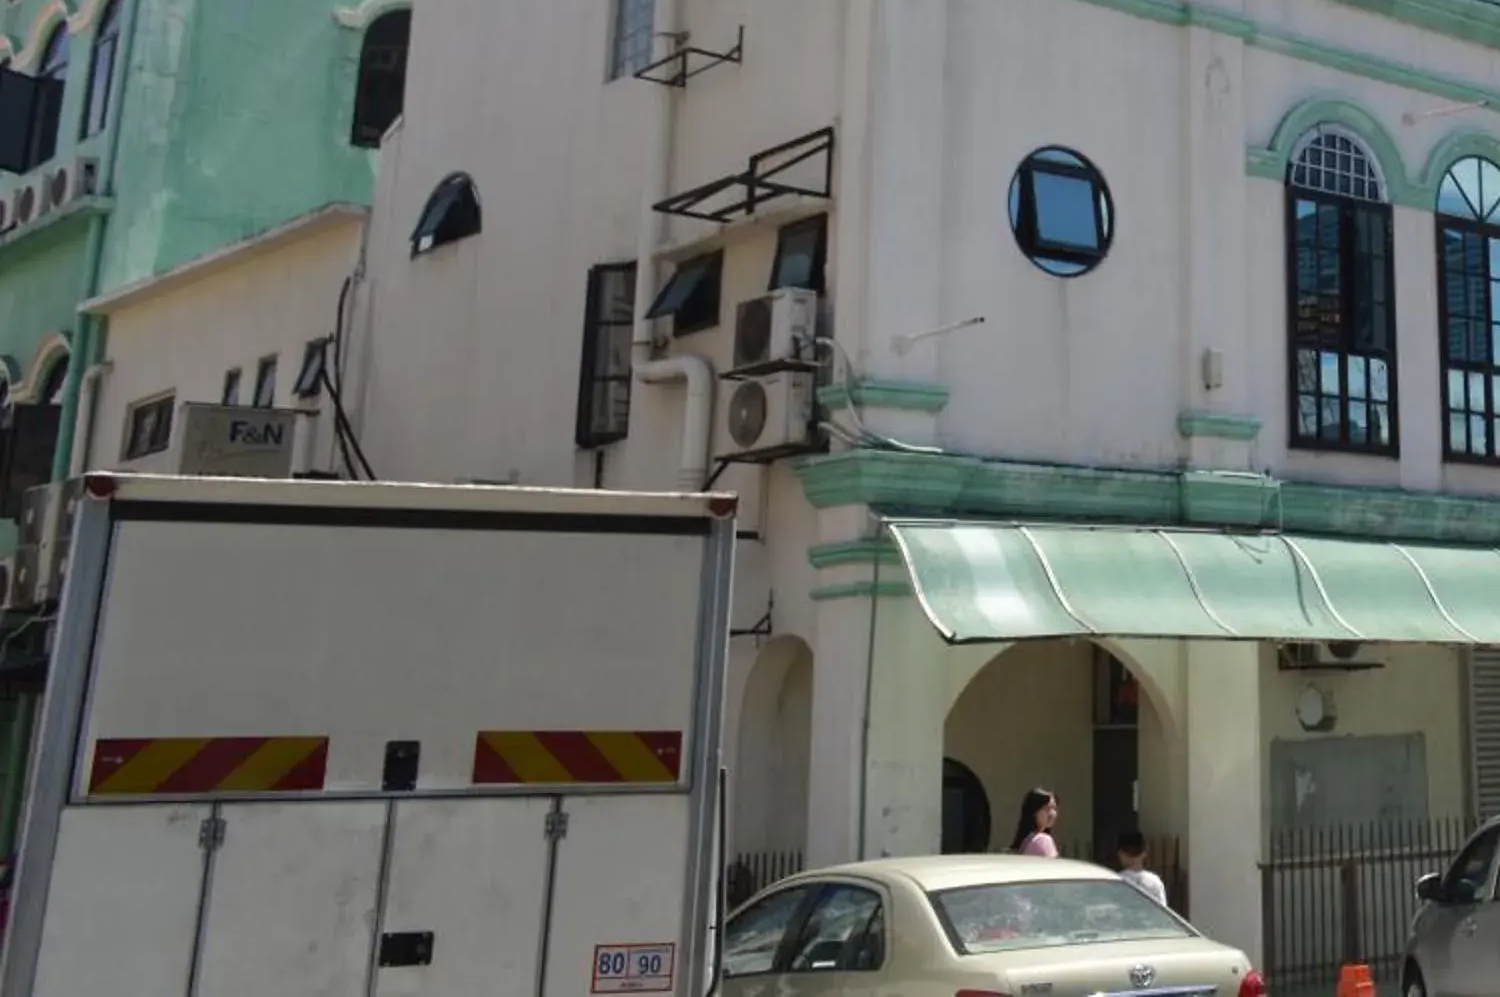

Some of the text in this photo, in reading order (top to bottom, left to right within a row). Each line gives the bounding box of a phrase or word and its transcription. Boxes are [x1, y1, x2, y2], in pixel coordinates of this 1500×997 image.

[230, 420, 283, 444] F&N
[599, 952, 662, 975] 80 90
